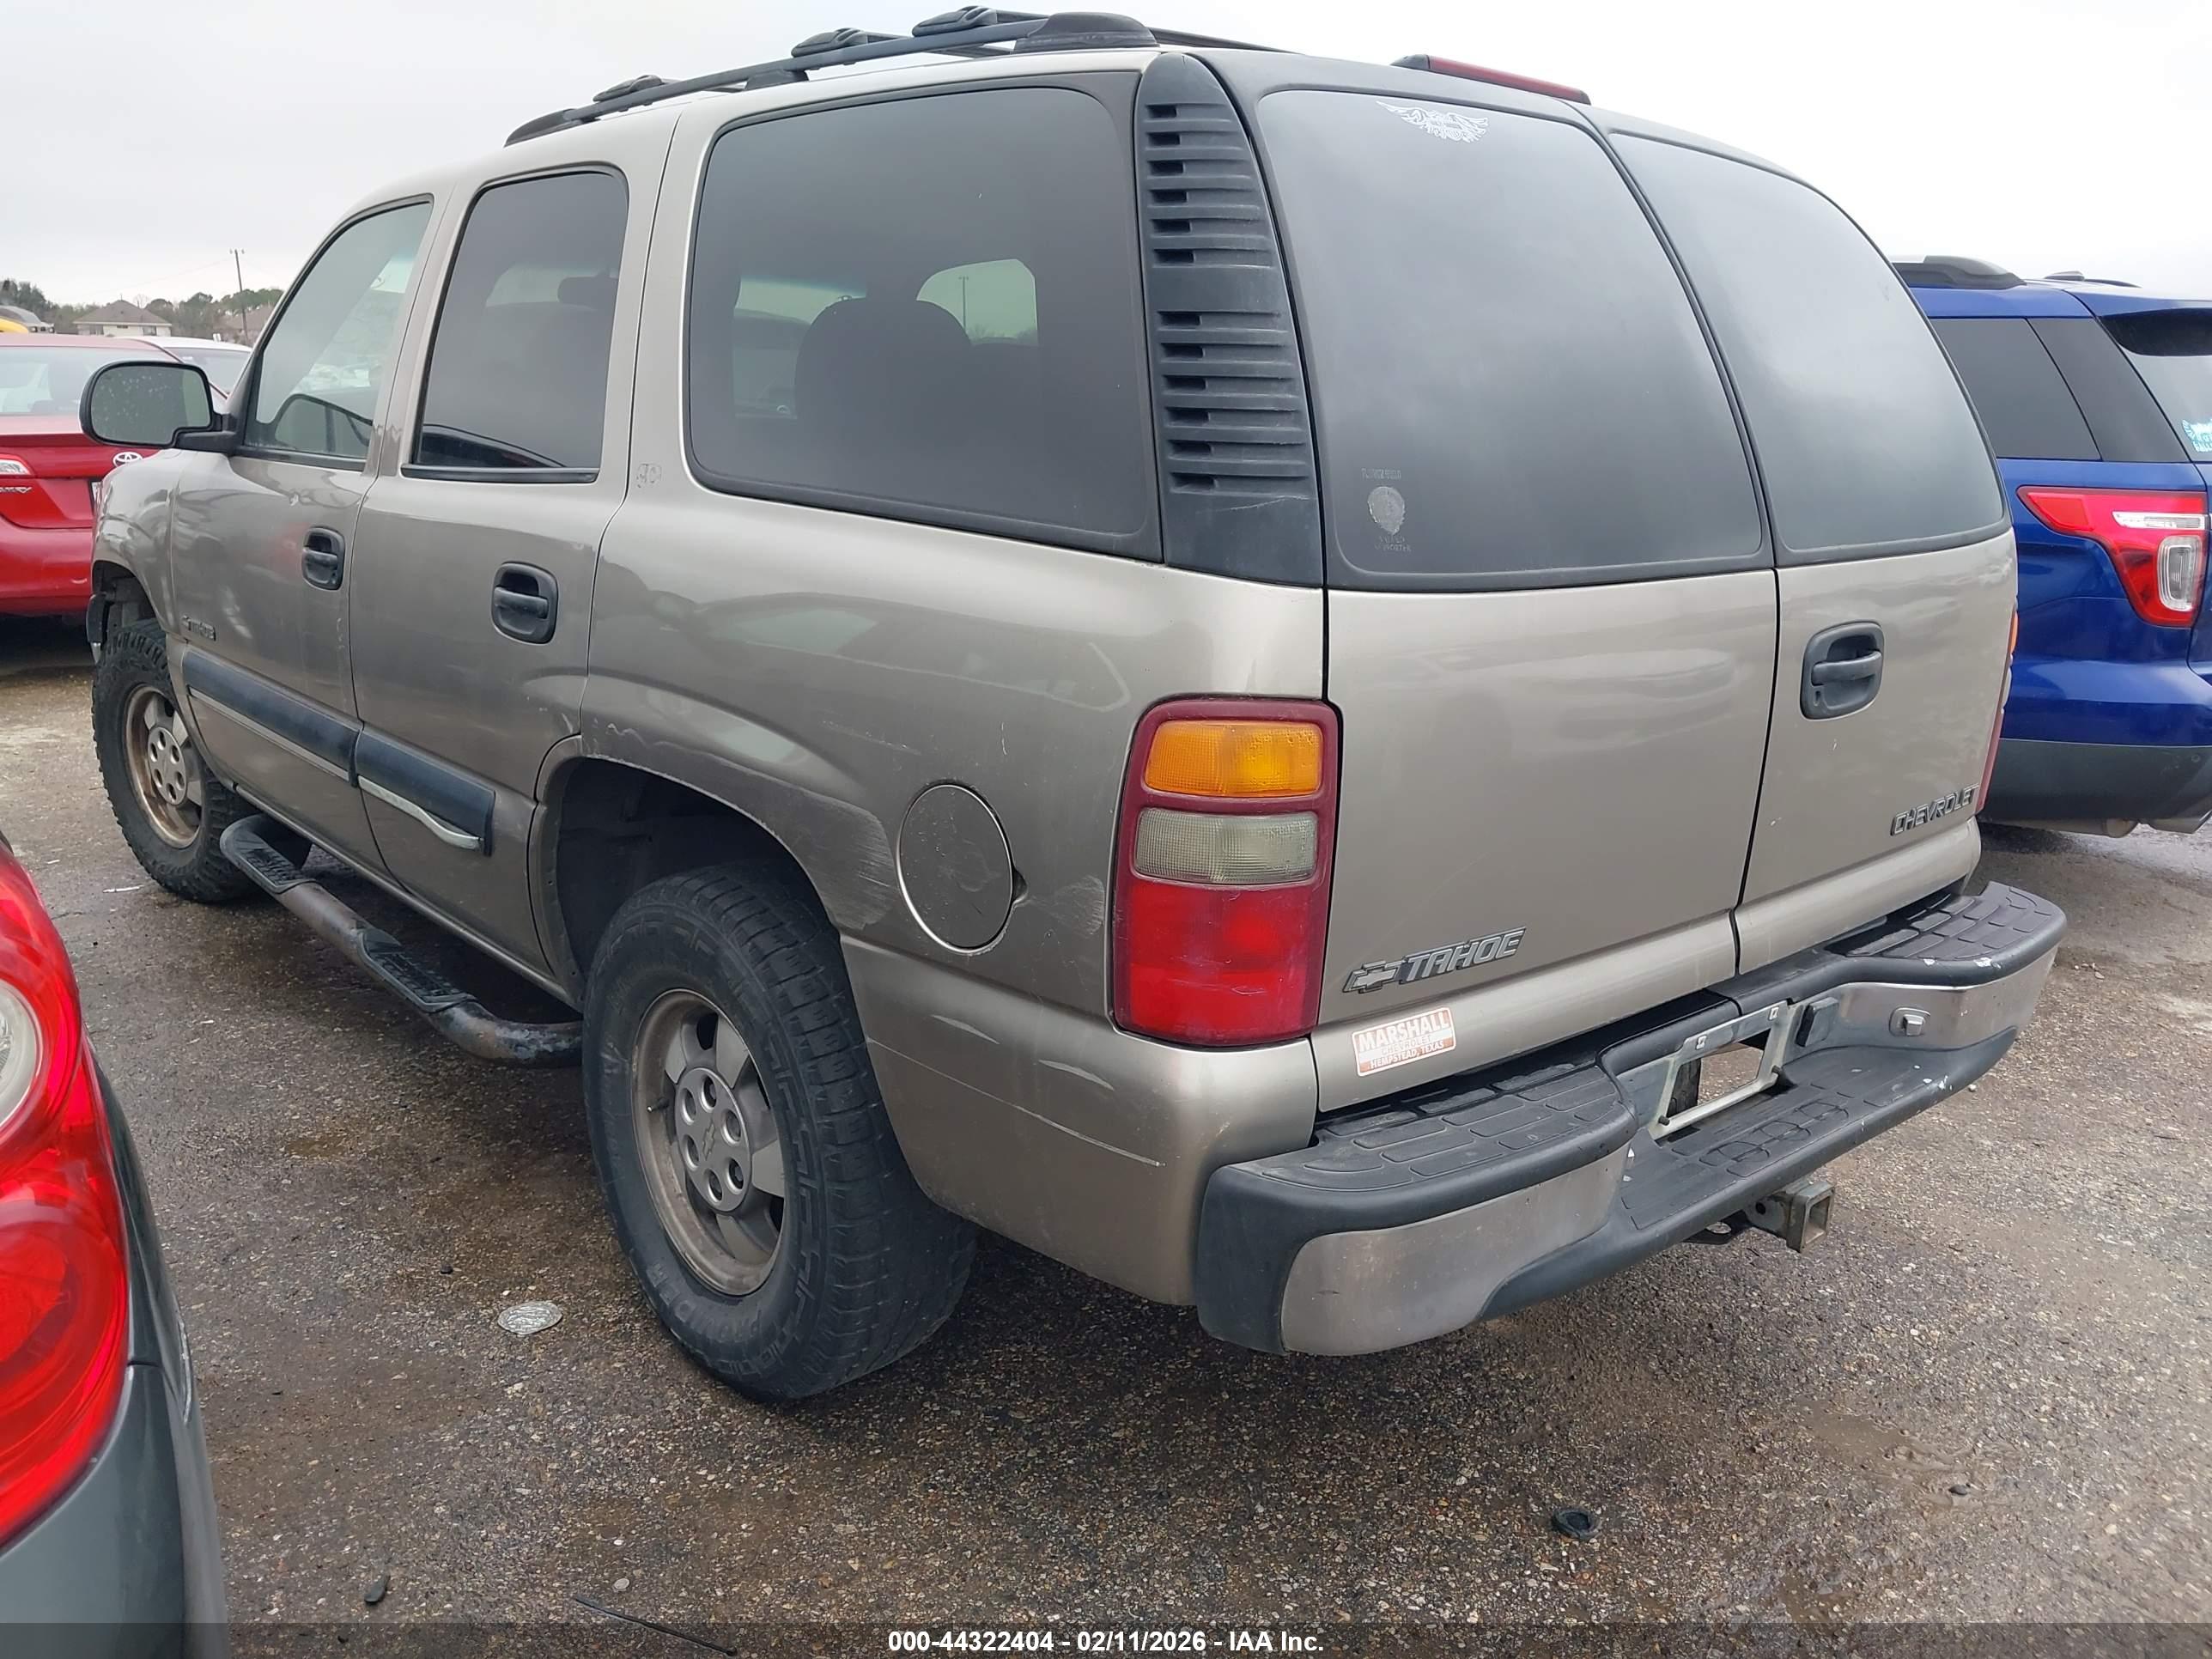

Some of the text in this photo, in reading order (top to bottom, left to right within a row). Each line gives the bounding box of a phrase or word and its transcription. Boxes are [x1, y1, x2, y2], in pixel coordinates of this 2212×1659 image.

[1890, 782, 1980, 836] CHEVROLET
[1406, 929, 1526, 982] TAHOE
[1358, 1012, 1450, 1052] MARSHALL
[1370, 1040, 1444, 1069] HEMPSTEAD, TEXAS
